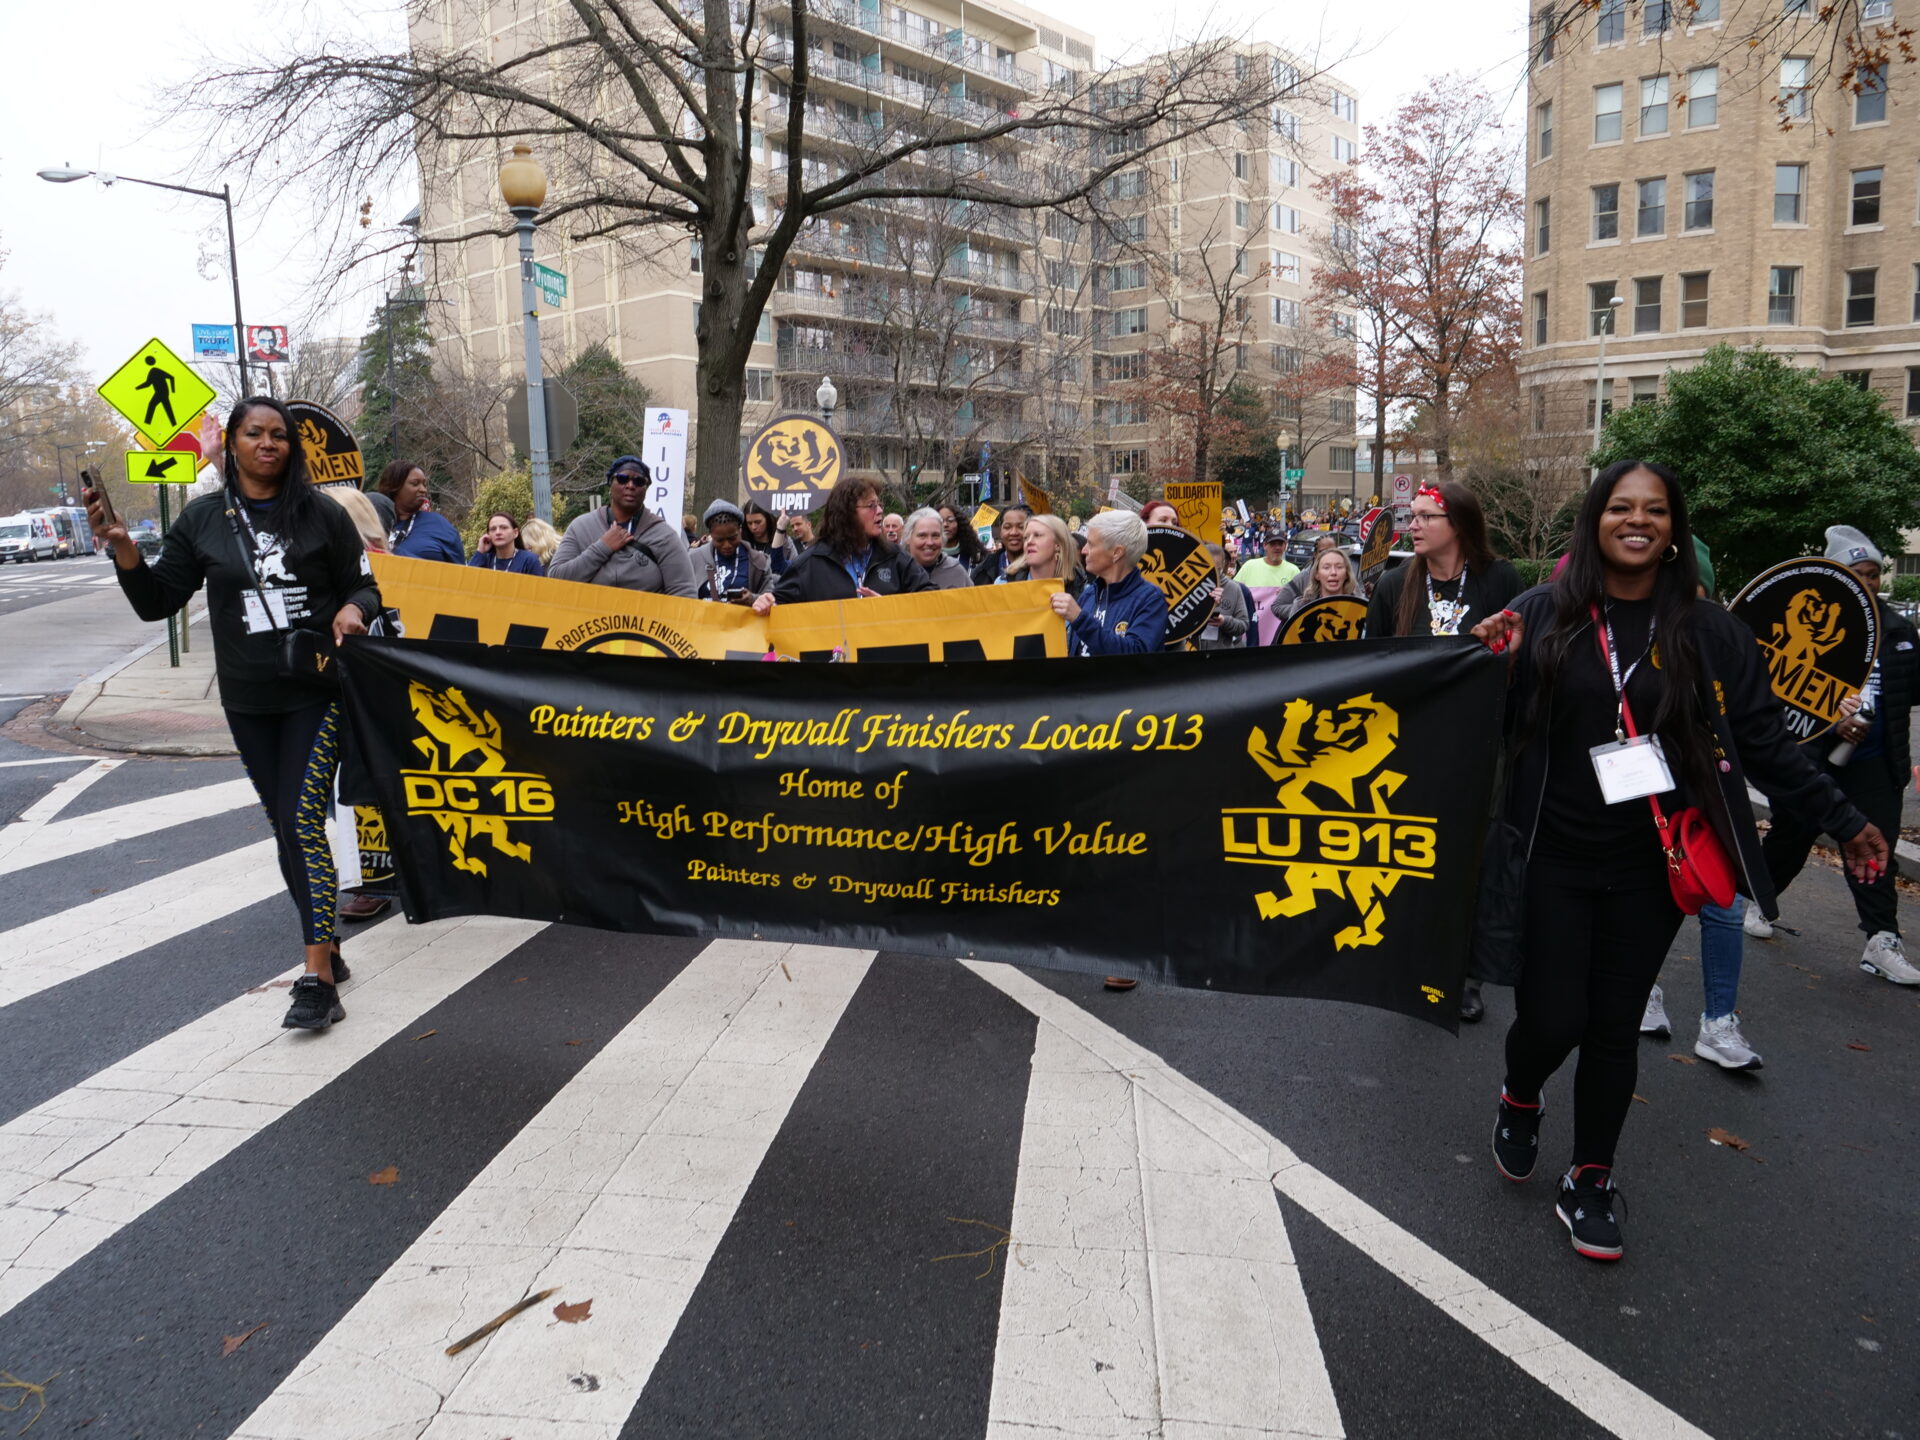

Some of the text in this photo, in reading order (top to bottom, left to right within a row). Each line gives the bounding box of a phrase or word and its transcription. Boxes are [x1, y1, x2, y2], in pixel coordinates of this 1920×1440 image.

[197, 336, 230, 345] TRUTH
[311, 453, 359, 480] MEN
[771, 493, 811, 511] IUPAT
[1166, 484, 1220, 500] SOLIDARITY!
[1164, 551, 1210, 600] MEN
[1168, 577, 1216, 628] ACTION
[1745, 566, 1875, 663] INTERNATIONAL UNION OF PAINTERS AND ALLIED TRADES
[555, 615, 645, 650] PROFESSIONAL
[1771, 655, 1849, 718] MEN
[529, 704, 1204, 759] Painters & Drywall Finishers Local 913
[403, 775, 555, 814] DC 16
[779, 768, 908, 809] Home of
[617, 801, 1148, 866] High Performance/High Value
[1222, 816, 1437, 868] LU 913
[688, 859, 1061, 906] Painters & Drywall Finishers
[1421, 985, 1445, 998] MERRILL
